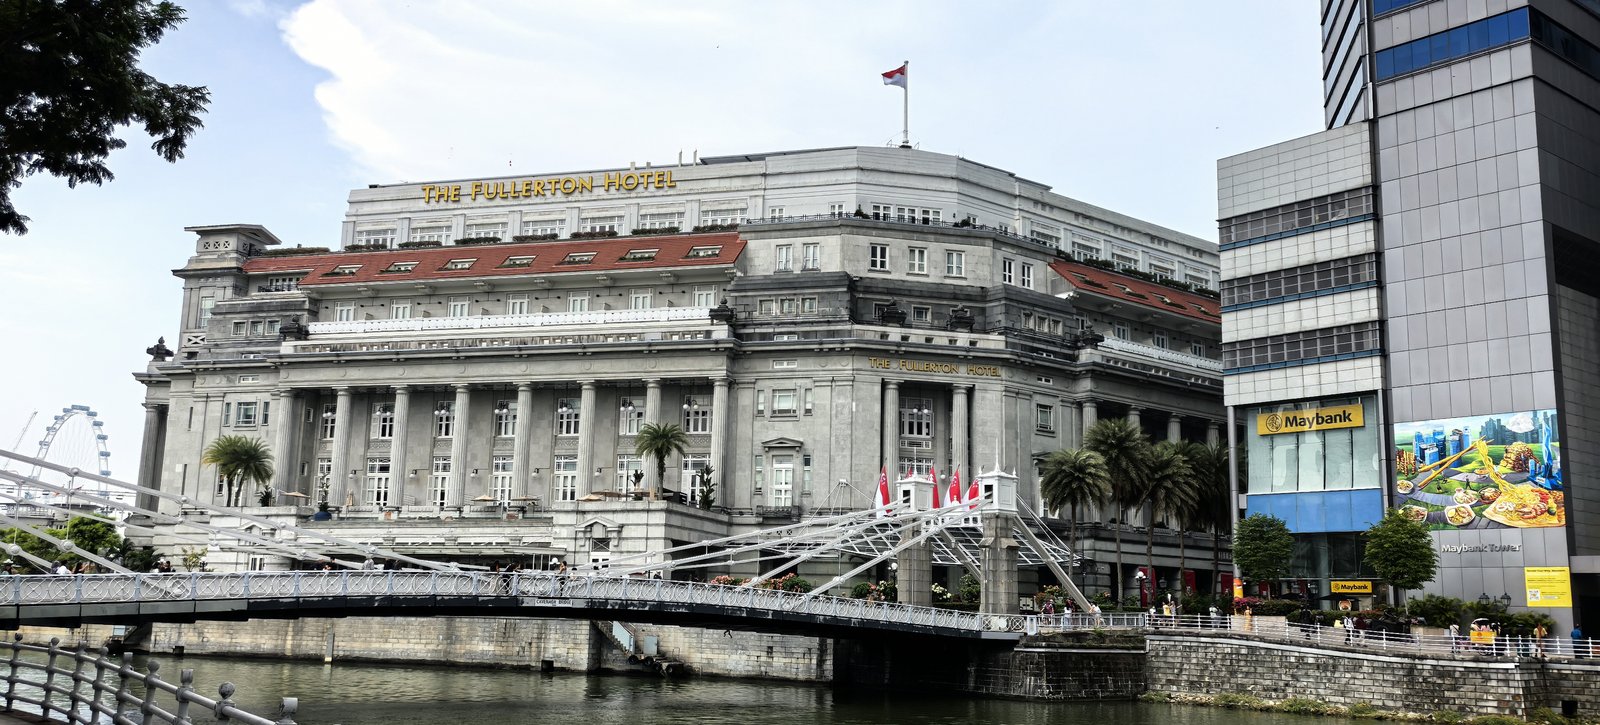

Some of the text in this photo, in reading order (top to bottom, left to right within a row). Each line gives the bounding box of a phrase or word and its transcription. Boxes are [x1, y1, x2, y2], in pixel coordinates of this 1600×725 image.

[422, 170, 677, 203] THE FULLERTON HOTEL
[868, 356, 1001, 377] THE FULLERTON HOTEL
[1285, 410, 1352, 429] Maybank
[1441, 543, 1521, 554] Maybank Tower
